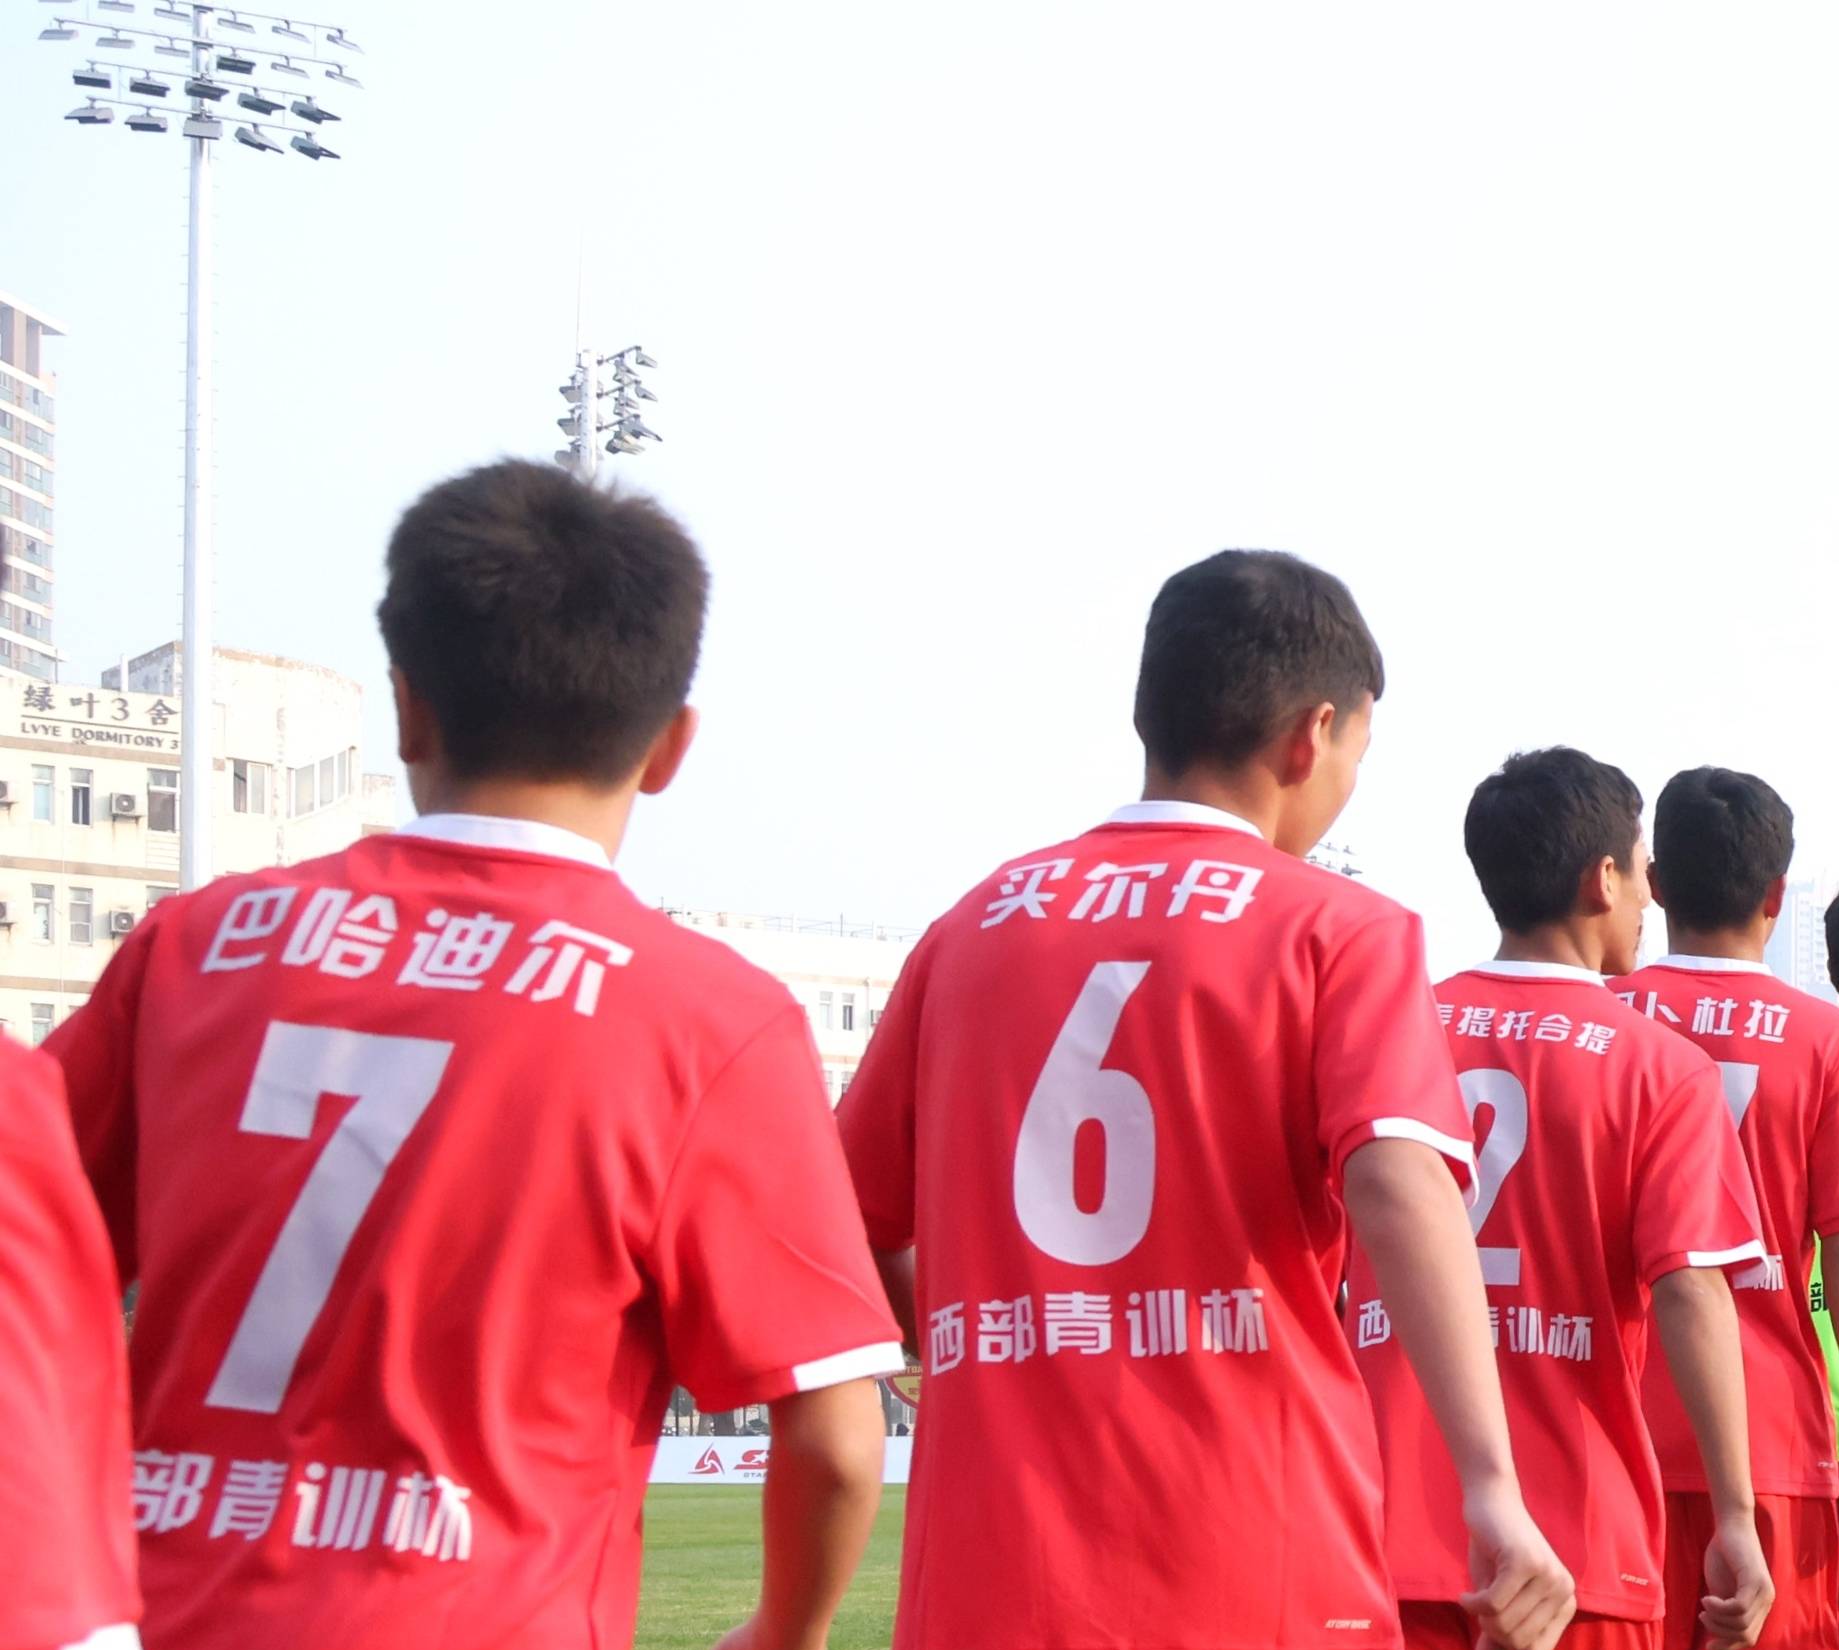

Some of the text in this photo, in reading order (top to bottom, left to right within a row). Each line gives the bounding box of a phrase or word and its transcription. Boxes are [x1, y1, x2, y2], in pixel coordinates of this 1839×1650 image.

[20, 721, 179, 750] LVYE DORMITORY 3
[979, 857, 1265, 929] 买尔丹
[201, 885, 634, 1017] 巴哈迪尔
[1615, 990, 1792, 1044] 卜杜拉
[1013, 960, 1156, 1267] 6
[205, 1020, 454, 1413] 7
[1456, 1067, 1529, 1286] 2
[928, 1287, 1270, 1377] 西部青训杯
